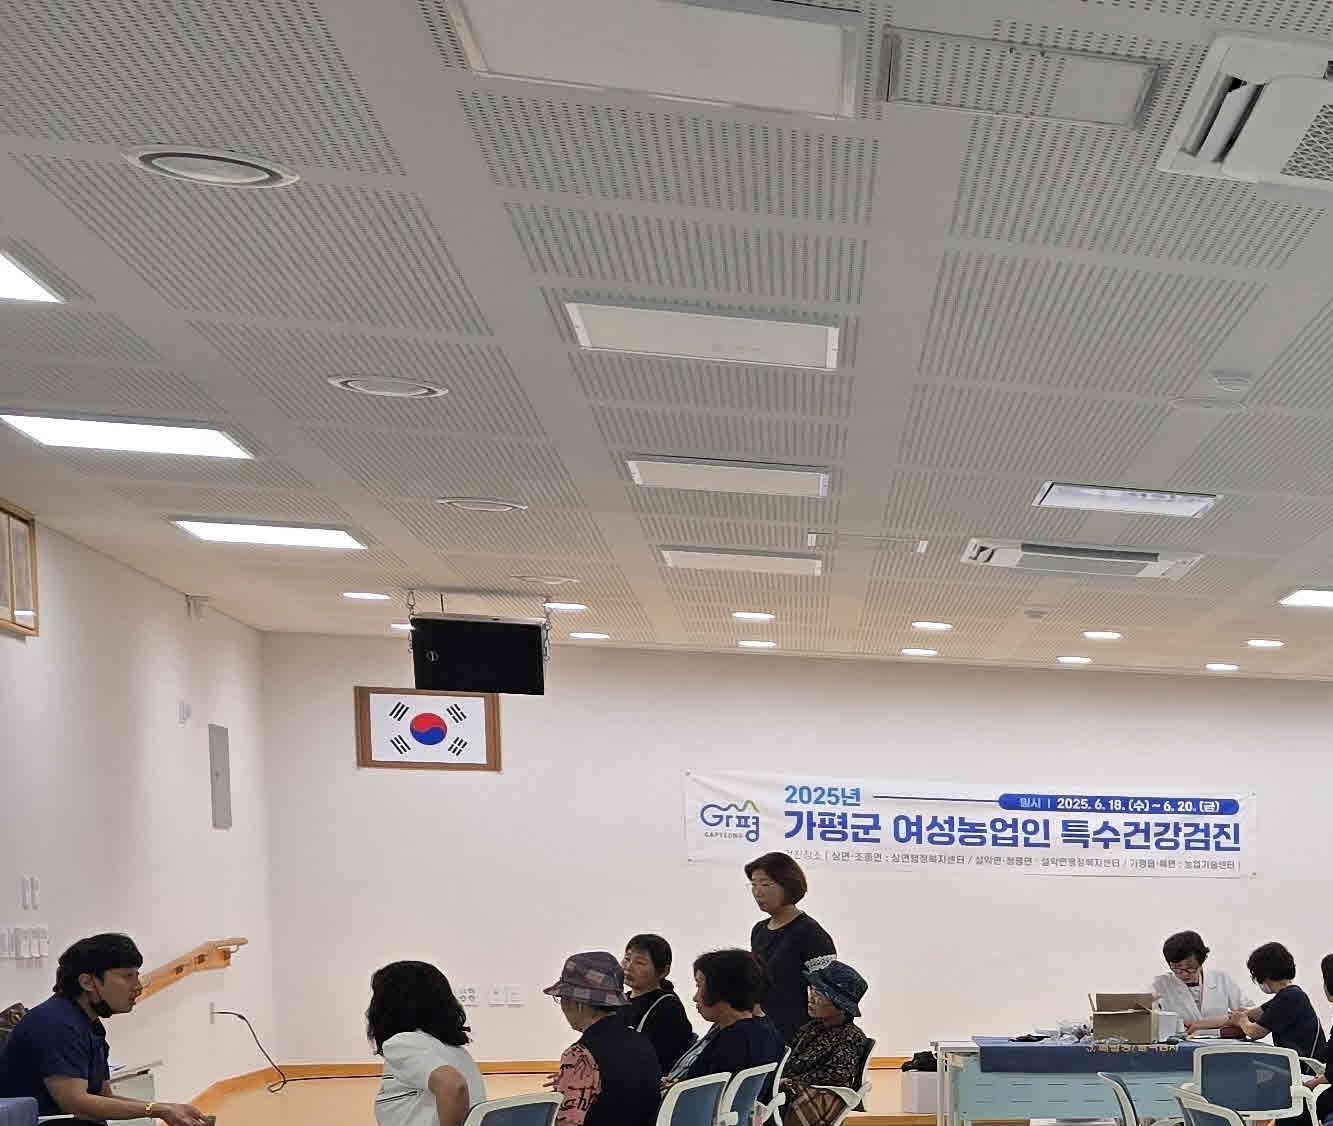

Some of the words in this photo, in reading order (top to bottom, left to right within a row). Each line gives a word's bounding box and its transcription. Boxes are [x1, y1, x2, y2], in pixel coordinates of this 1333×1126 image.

[784, 785, 861, 806] 2025년
[1057, 798, 1091, 810] 2025.
[1199, 801, 1220, 813] (금)
[784, 810, 881, 843] 가평군
[893, 814, 1050, 848] 여성농업인
[1061, 819, 1240, 851] 특수건강검진
